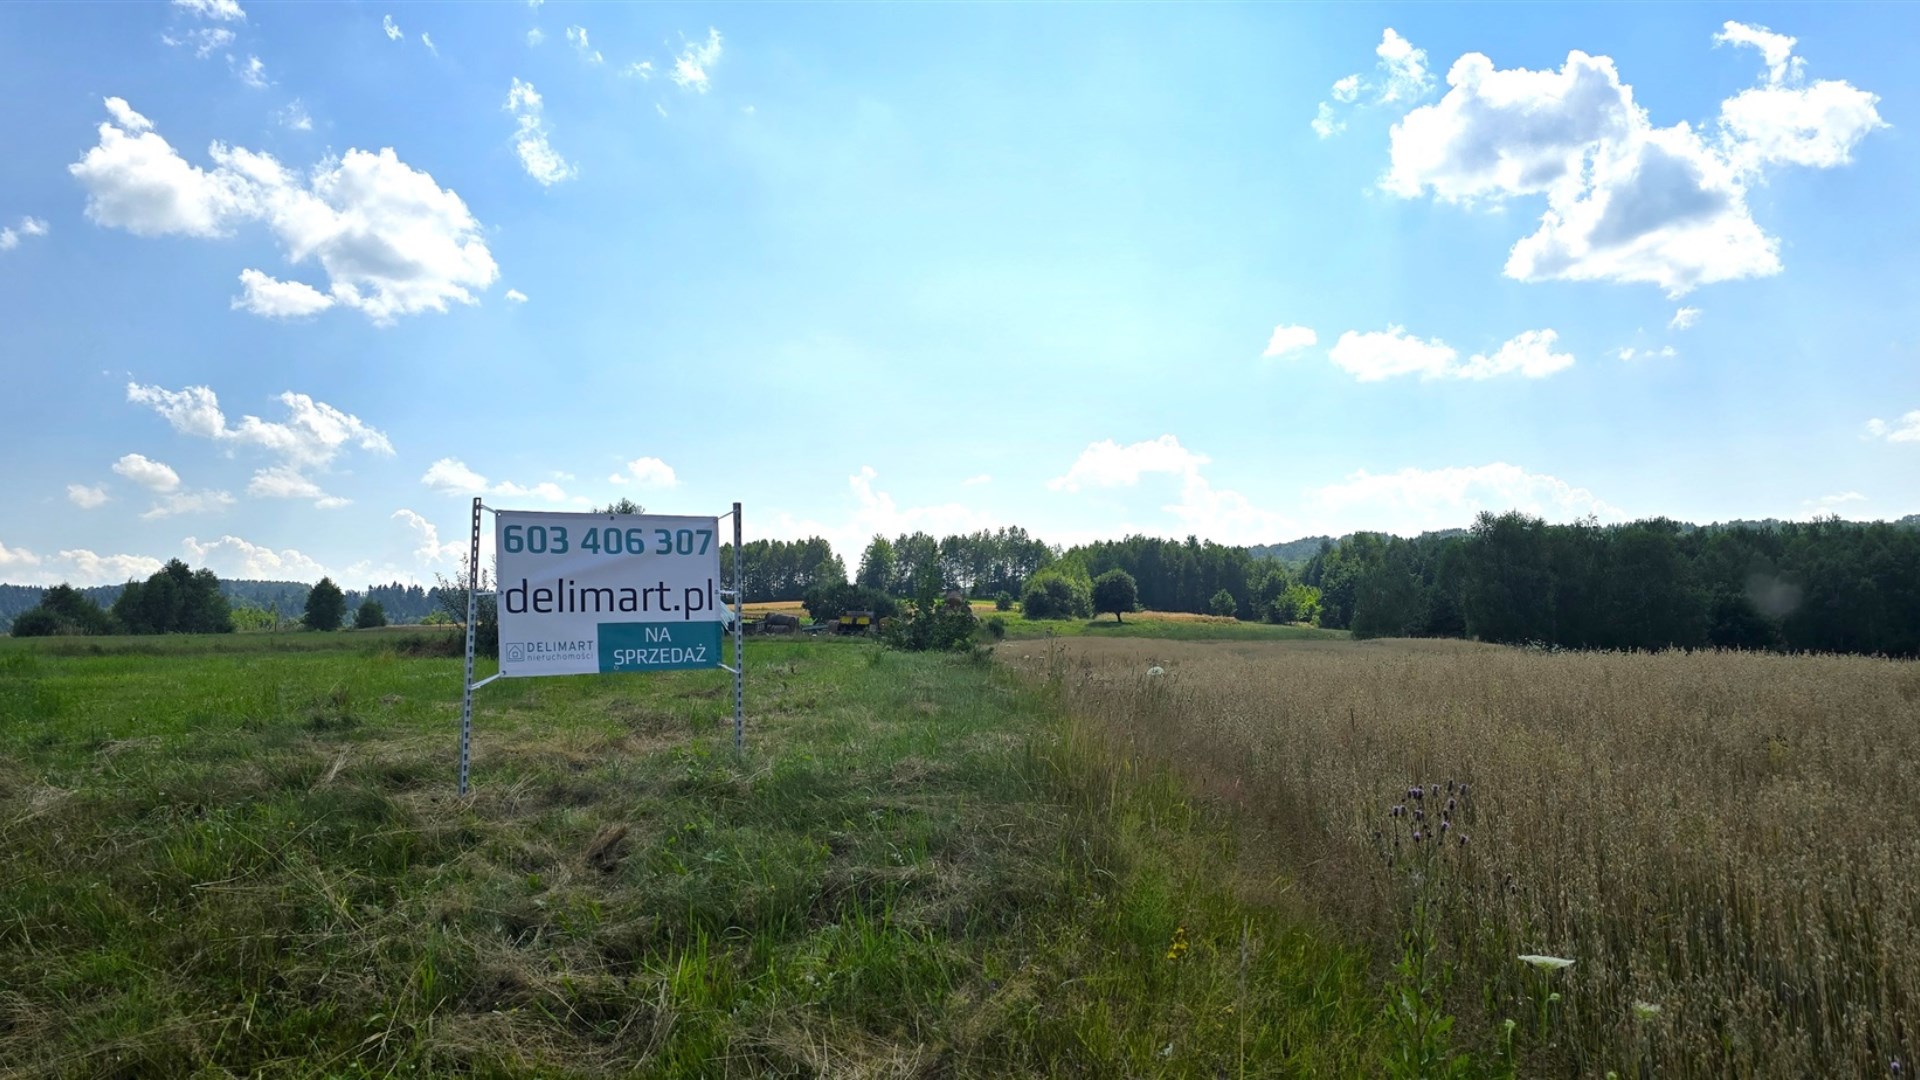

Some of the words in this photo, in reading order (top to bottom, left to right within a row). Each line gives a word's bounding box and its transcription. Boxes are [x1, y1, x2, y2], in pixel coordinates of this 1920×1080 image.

[503, 524, 569, 554] 603
[581, 527, 645, 555] 406
[655, 528, 713, 556] 307
[505, 578, 713, 620] delimart.pl
[527, 640, 594, 653] DELIMART
[645, 627, 672, 643] NA
[614, 643, 707, 666] SPRZEDAŻ
